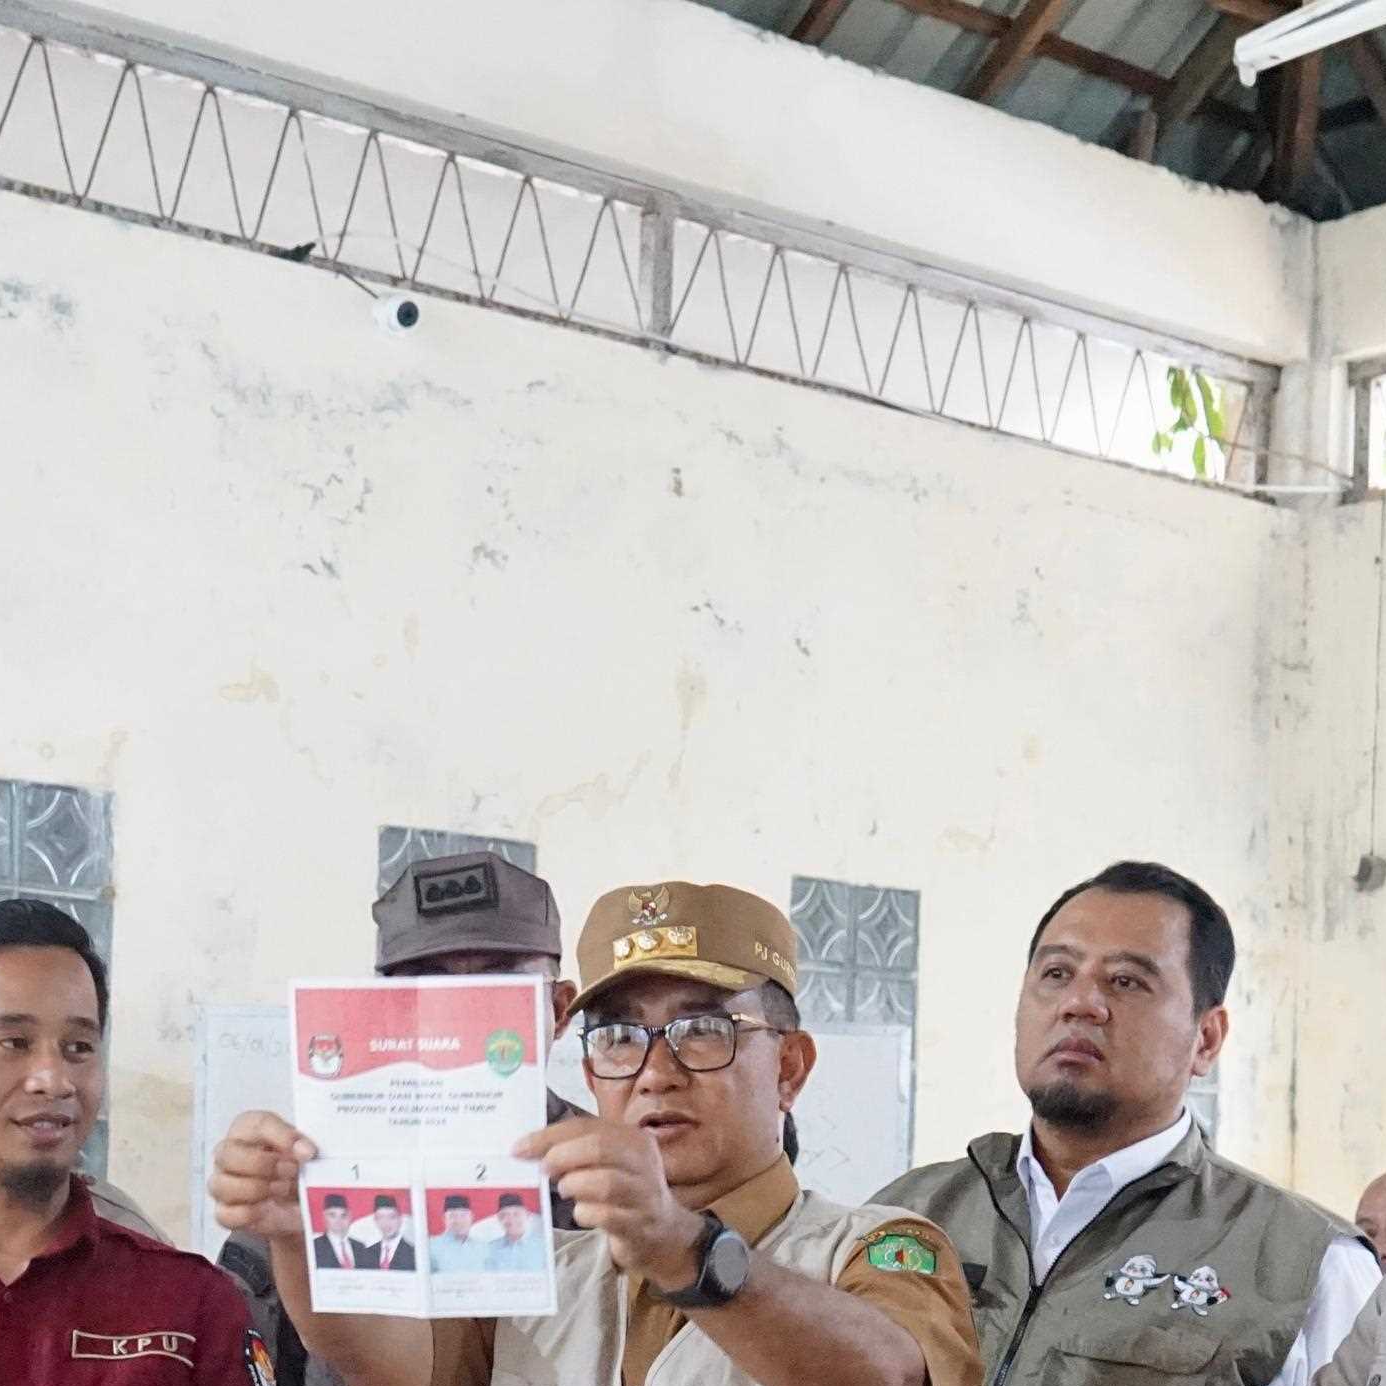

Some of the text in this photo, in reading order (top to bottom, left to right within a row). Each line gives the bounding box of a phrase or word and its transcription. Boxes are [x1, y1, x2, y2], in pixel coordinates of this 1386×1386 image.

[369, 1036, 461, 1052] SURAT SUARA
[351, 1165, 361, 1181] 1
[475, 1163, 488, 1181] 2
[113, 1334, 179, 1355] KPU
